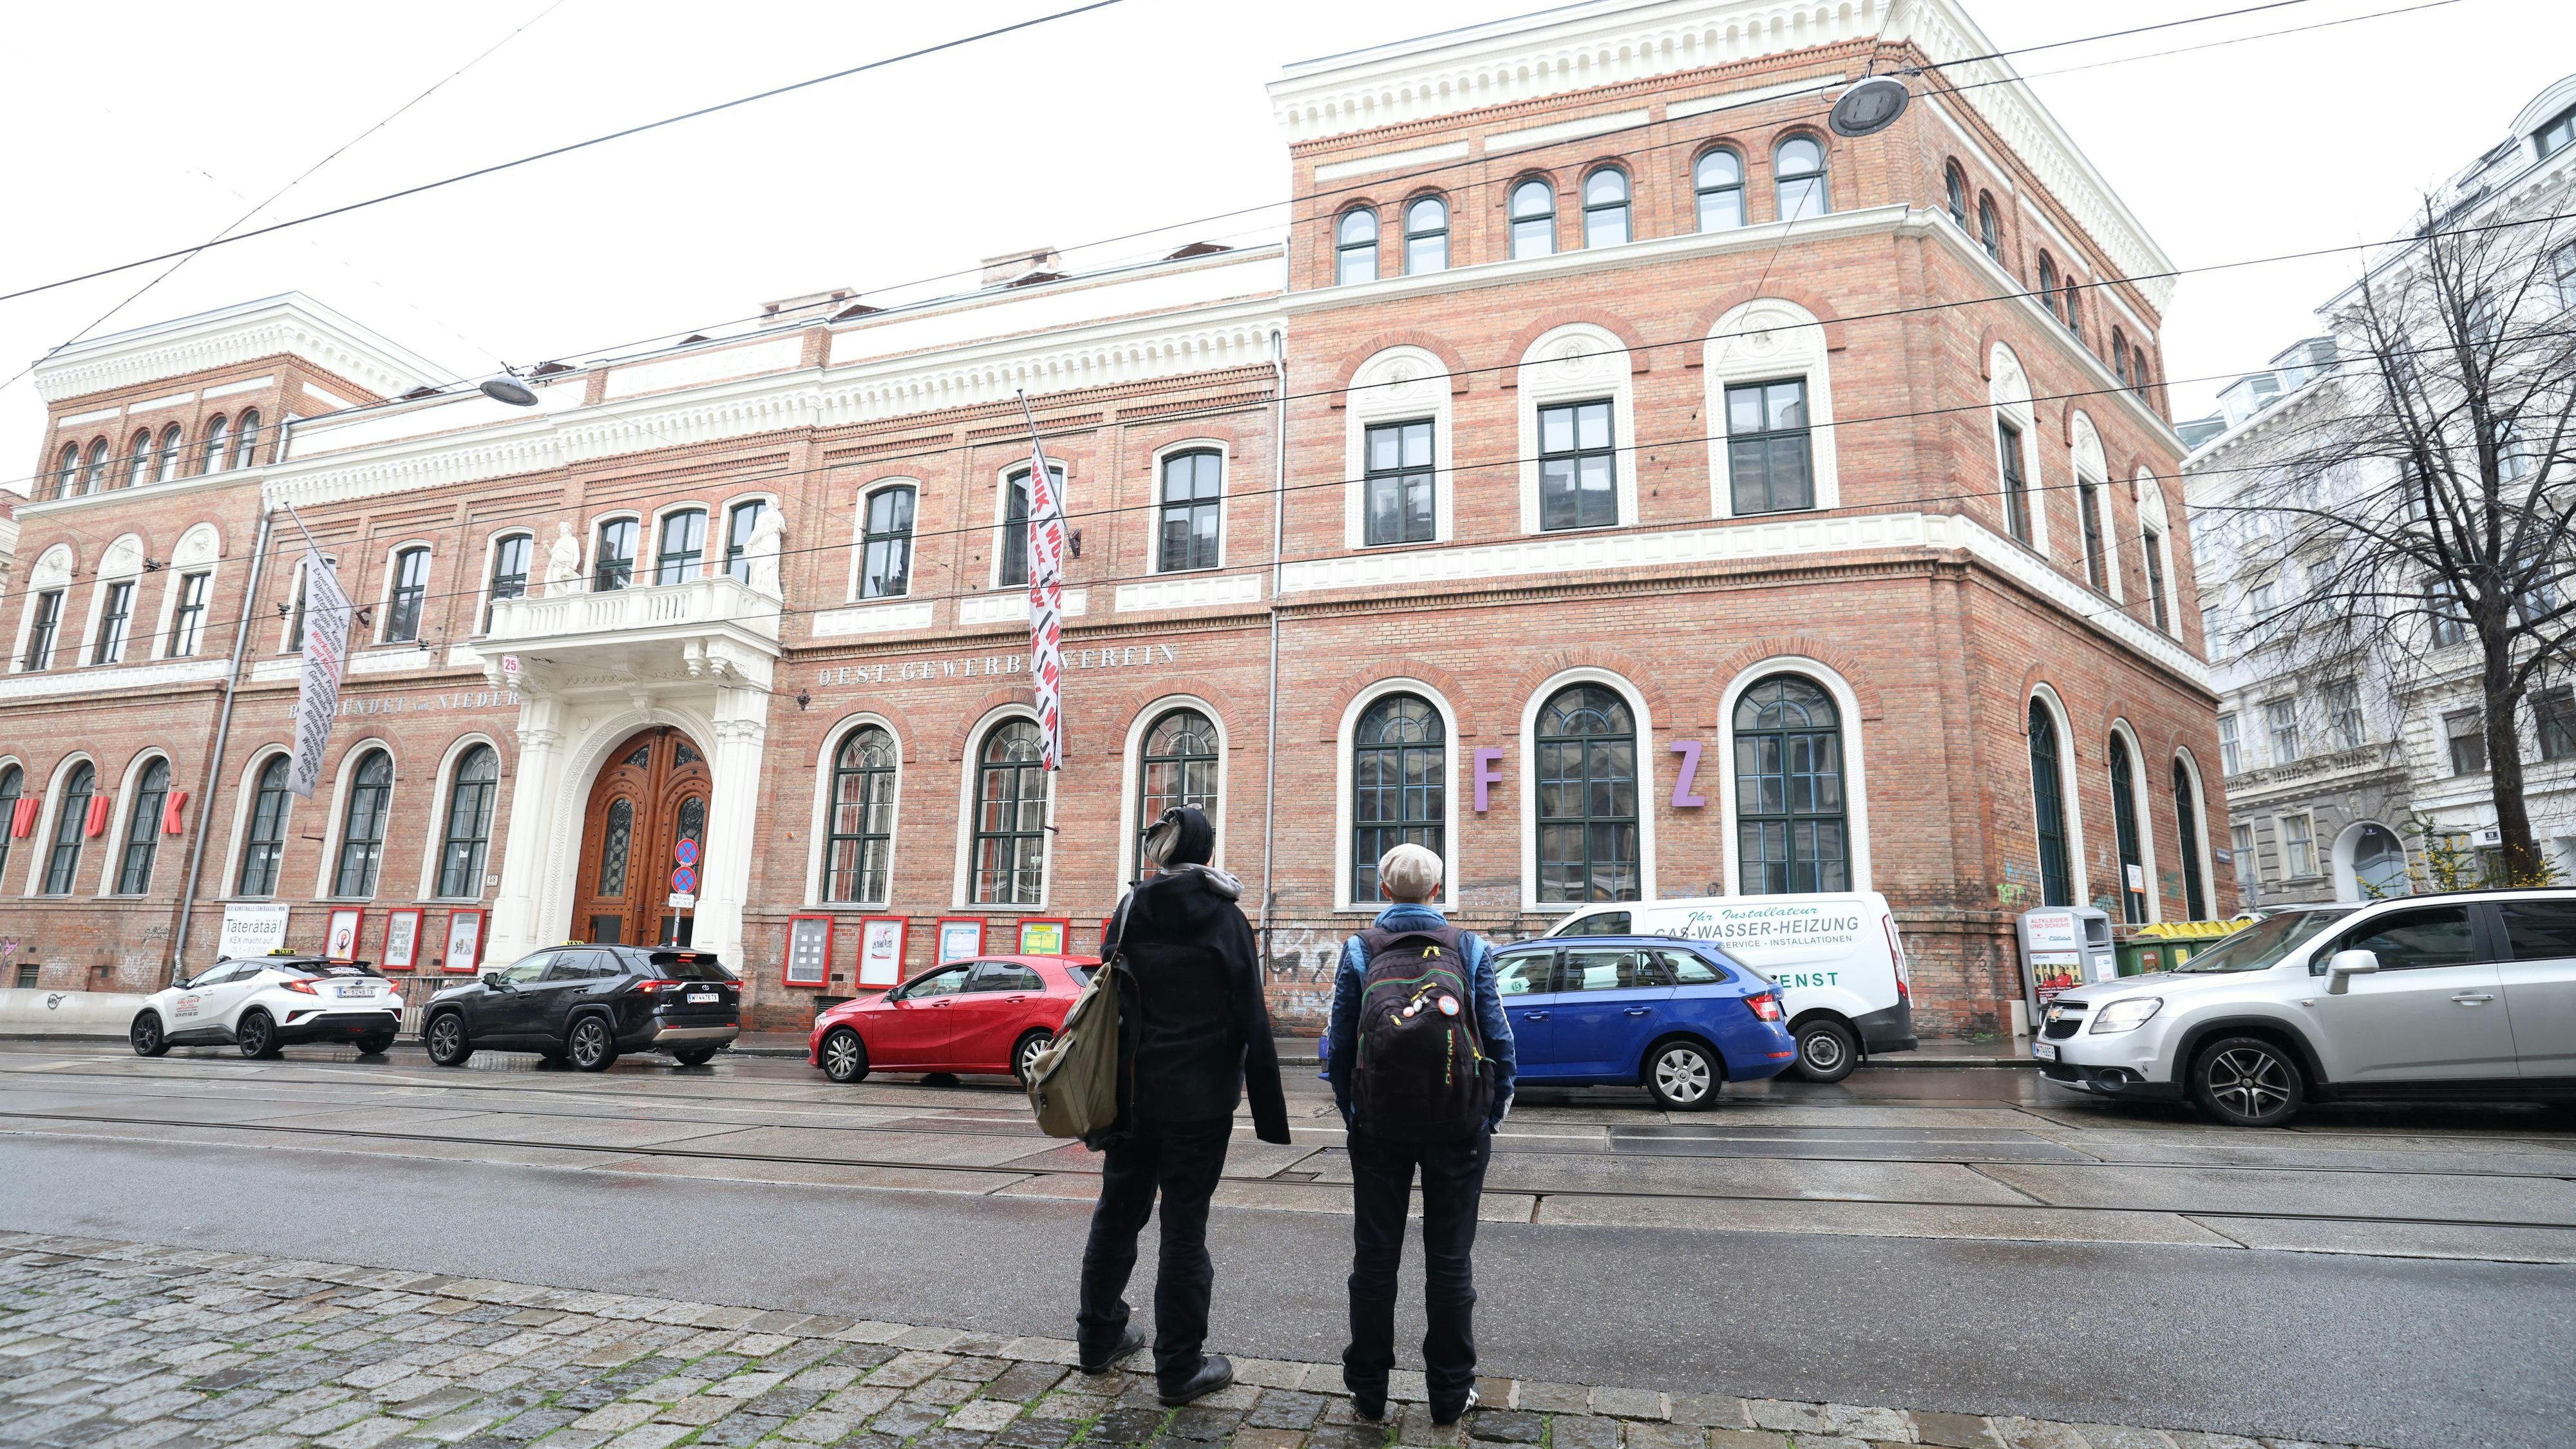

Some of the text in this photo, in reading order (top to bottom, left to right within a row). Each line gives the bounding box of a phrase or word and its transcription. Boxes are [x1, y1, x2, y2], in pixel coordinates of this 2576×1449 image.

[310, 644, 325, 658] und
[505, 659, 516, 671] 25
[819, 664, 891, 687] OEST.
[902, 645, 1176, 681] GEWERBVEREIN
[304, 709, 323, 736] Bildung
[1689, 906, 1819, 922] Ihr Installateur
[227, 919, 282, 933] Täterätää!
[1770, 935, 1853, 946] INSTALLATIONEN
[1513, 982, 1520, 990] 15
[1780, 972, 1839, 989] ENST
